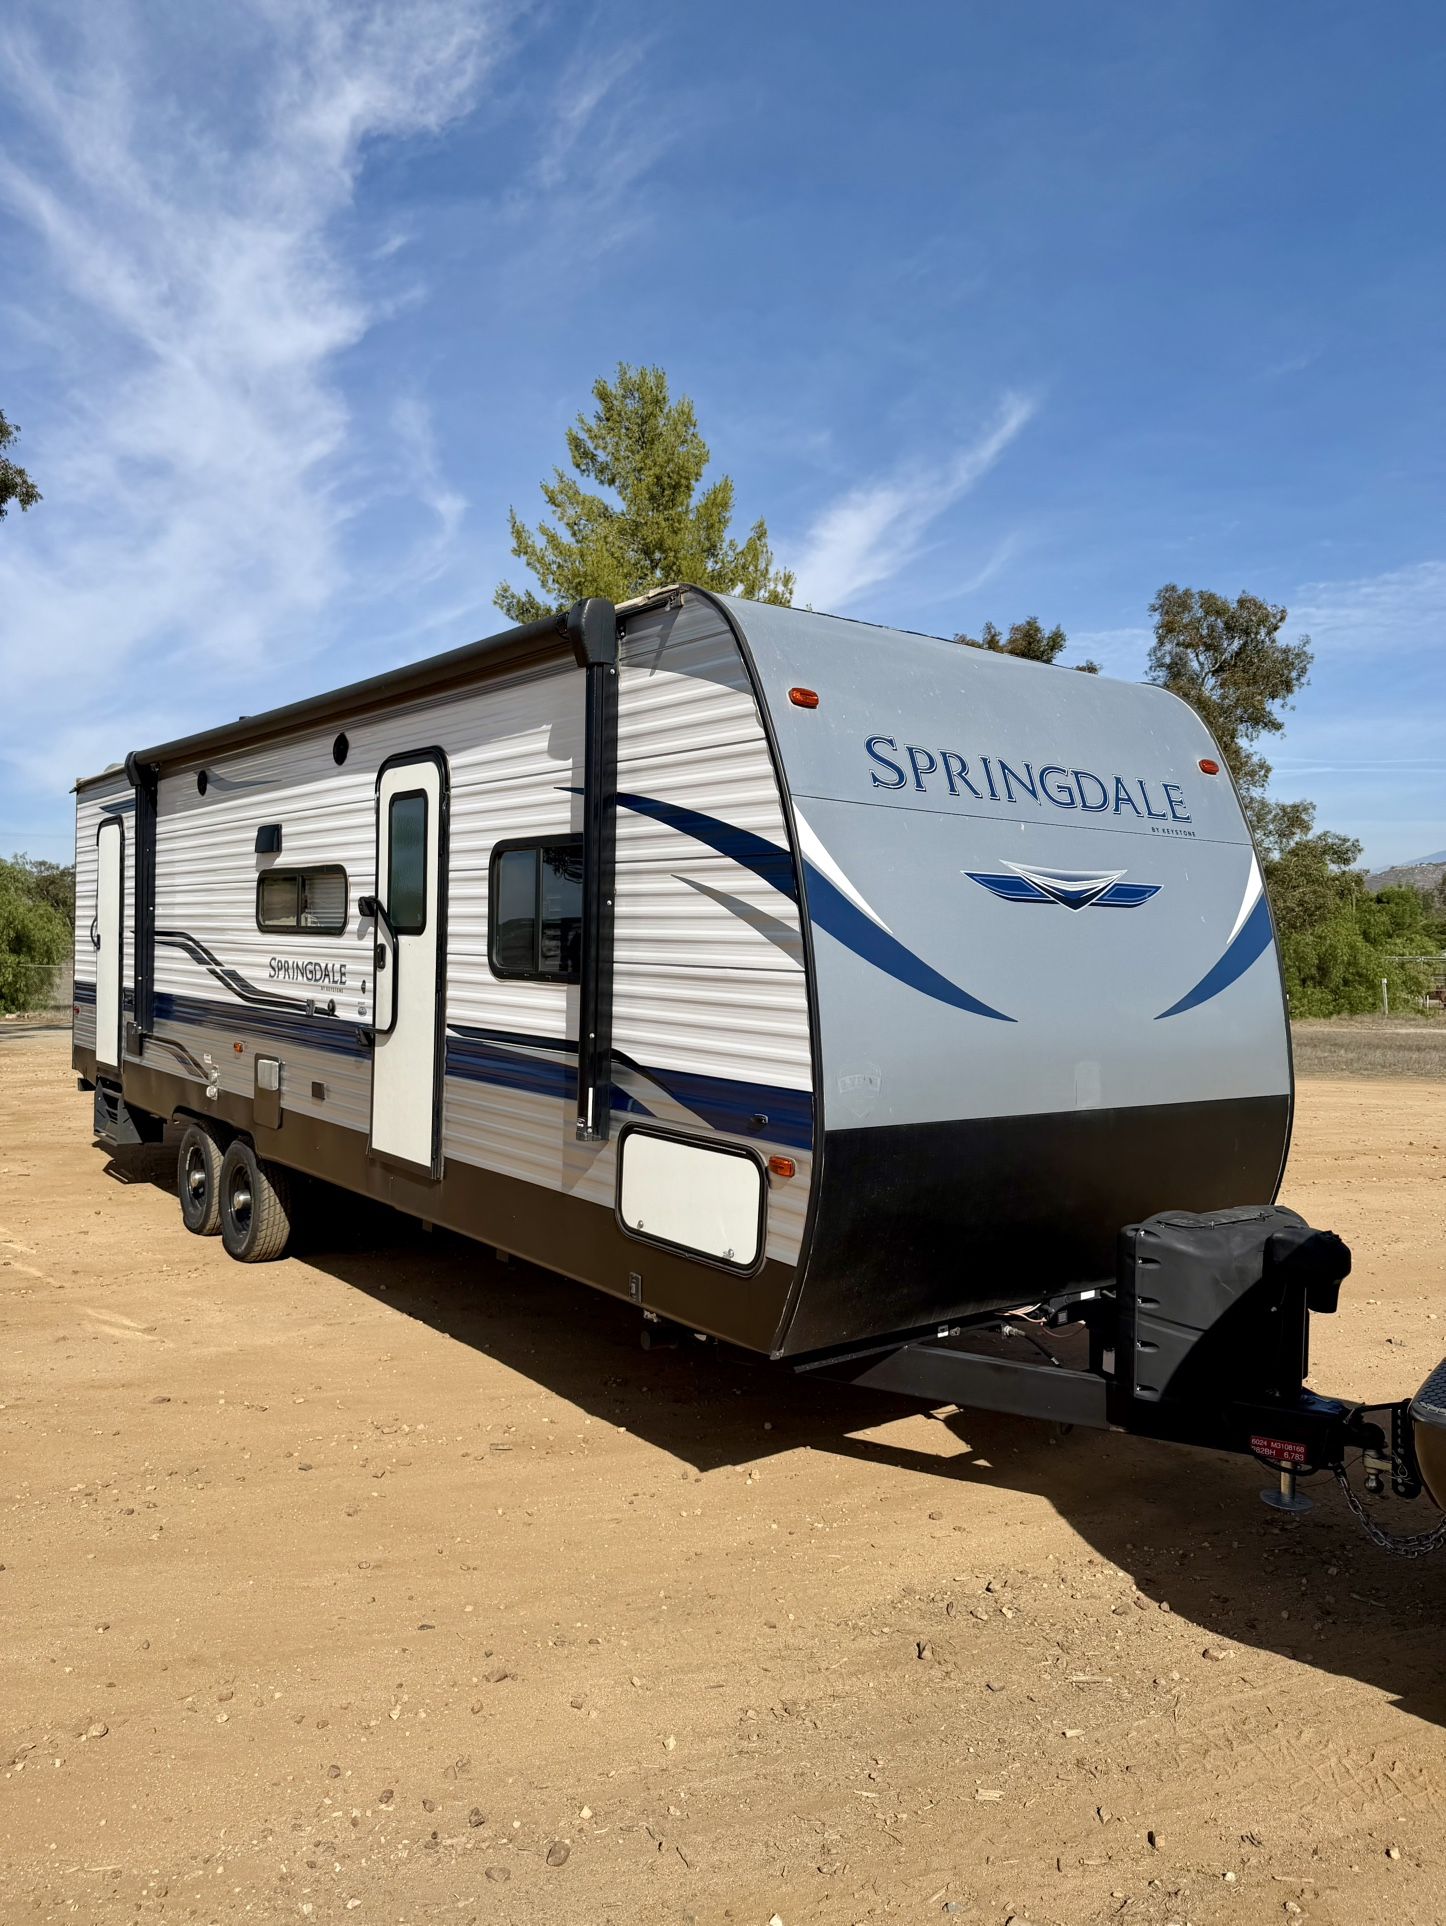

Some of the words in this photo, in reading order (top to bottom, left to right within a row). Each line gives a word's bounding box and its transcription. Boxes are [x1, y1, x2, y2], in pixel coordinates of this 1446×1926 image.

[864, 734, 1192, 823] SPRINGDALE
[1162, 828, 1196, 837] KEYSTONE
[269, 957, 347, 985] SPRINGDALE
